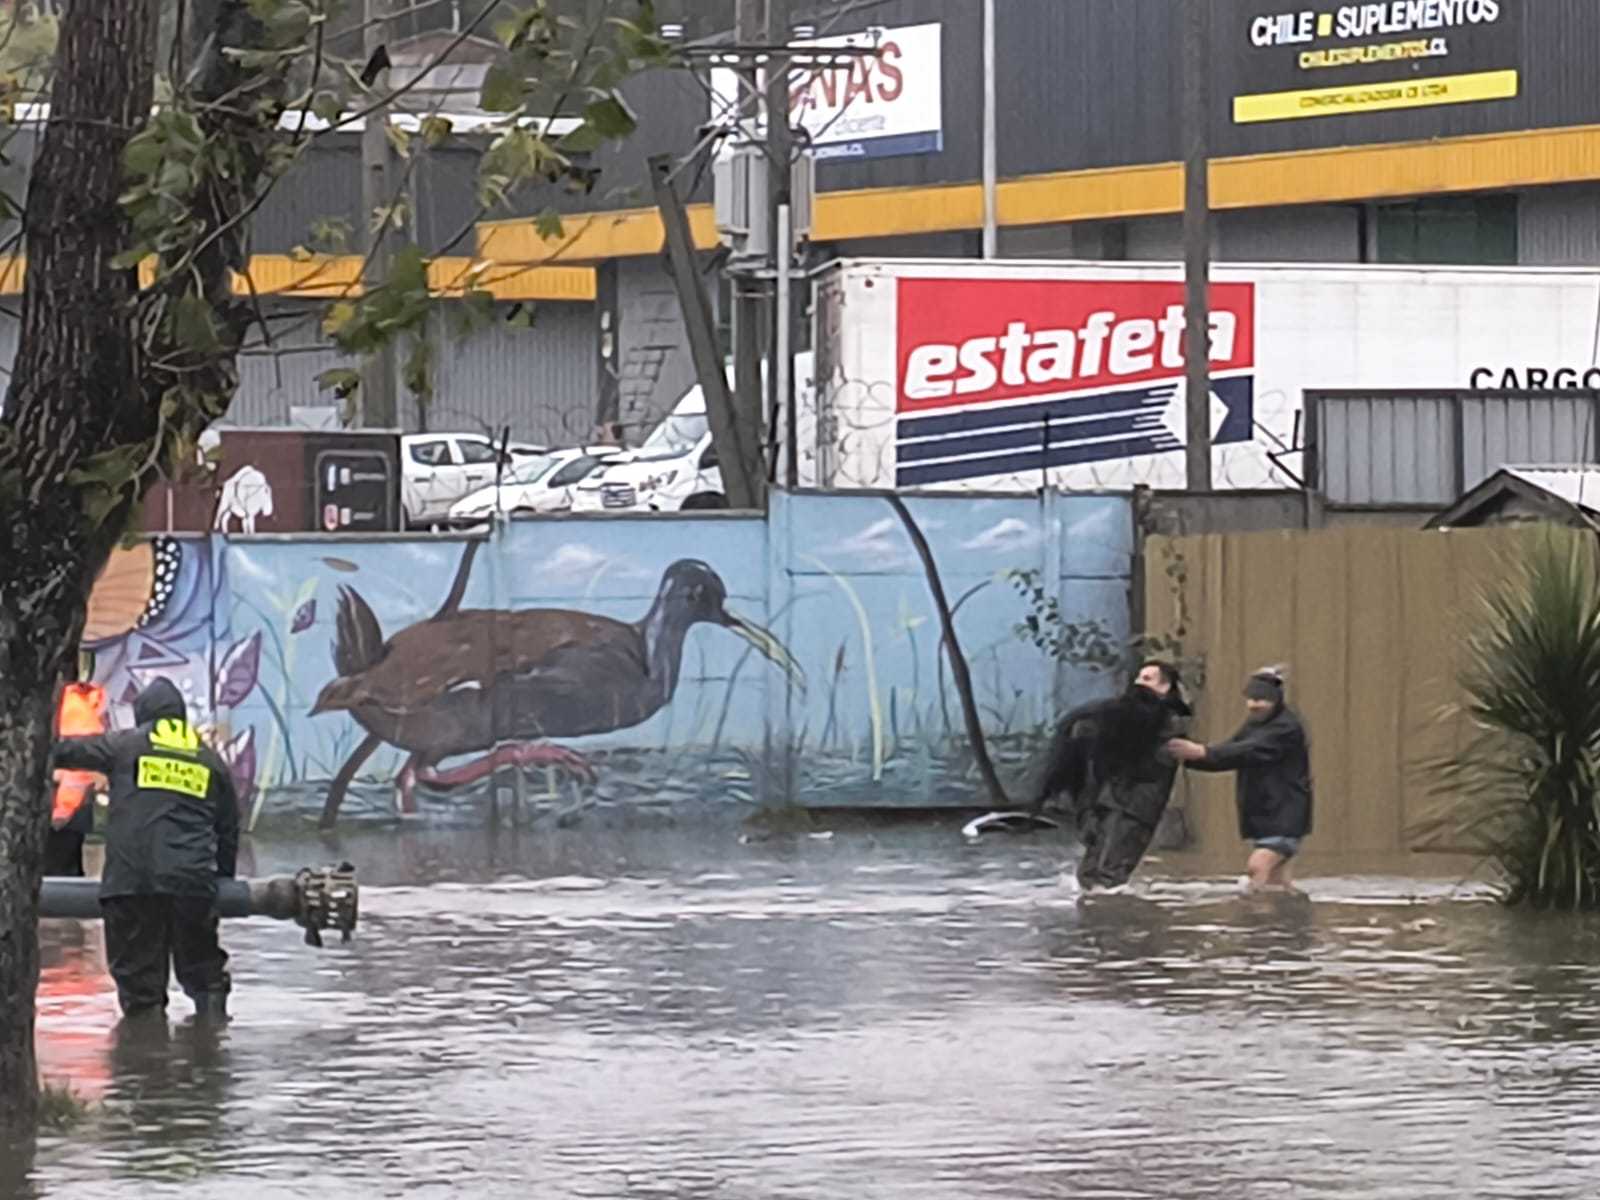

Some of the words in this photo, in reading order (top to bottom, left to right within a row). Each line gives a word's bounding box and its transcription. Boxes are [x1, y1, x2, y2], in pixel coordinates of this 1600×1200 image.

[1250, 11, 1314, 46] CHILE
[1335, 0, 1499, 38] SUPLEMENTOS
[903, 304, 1237, 400] estafeta
